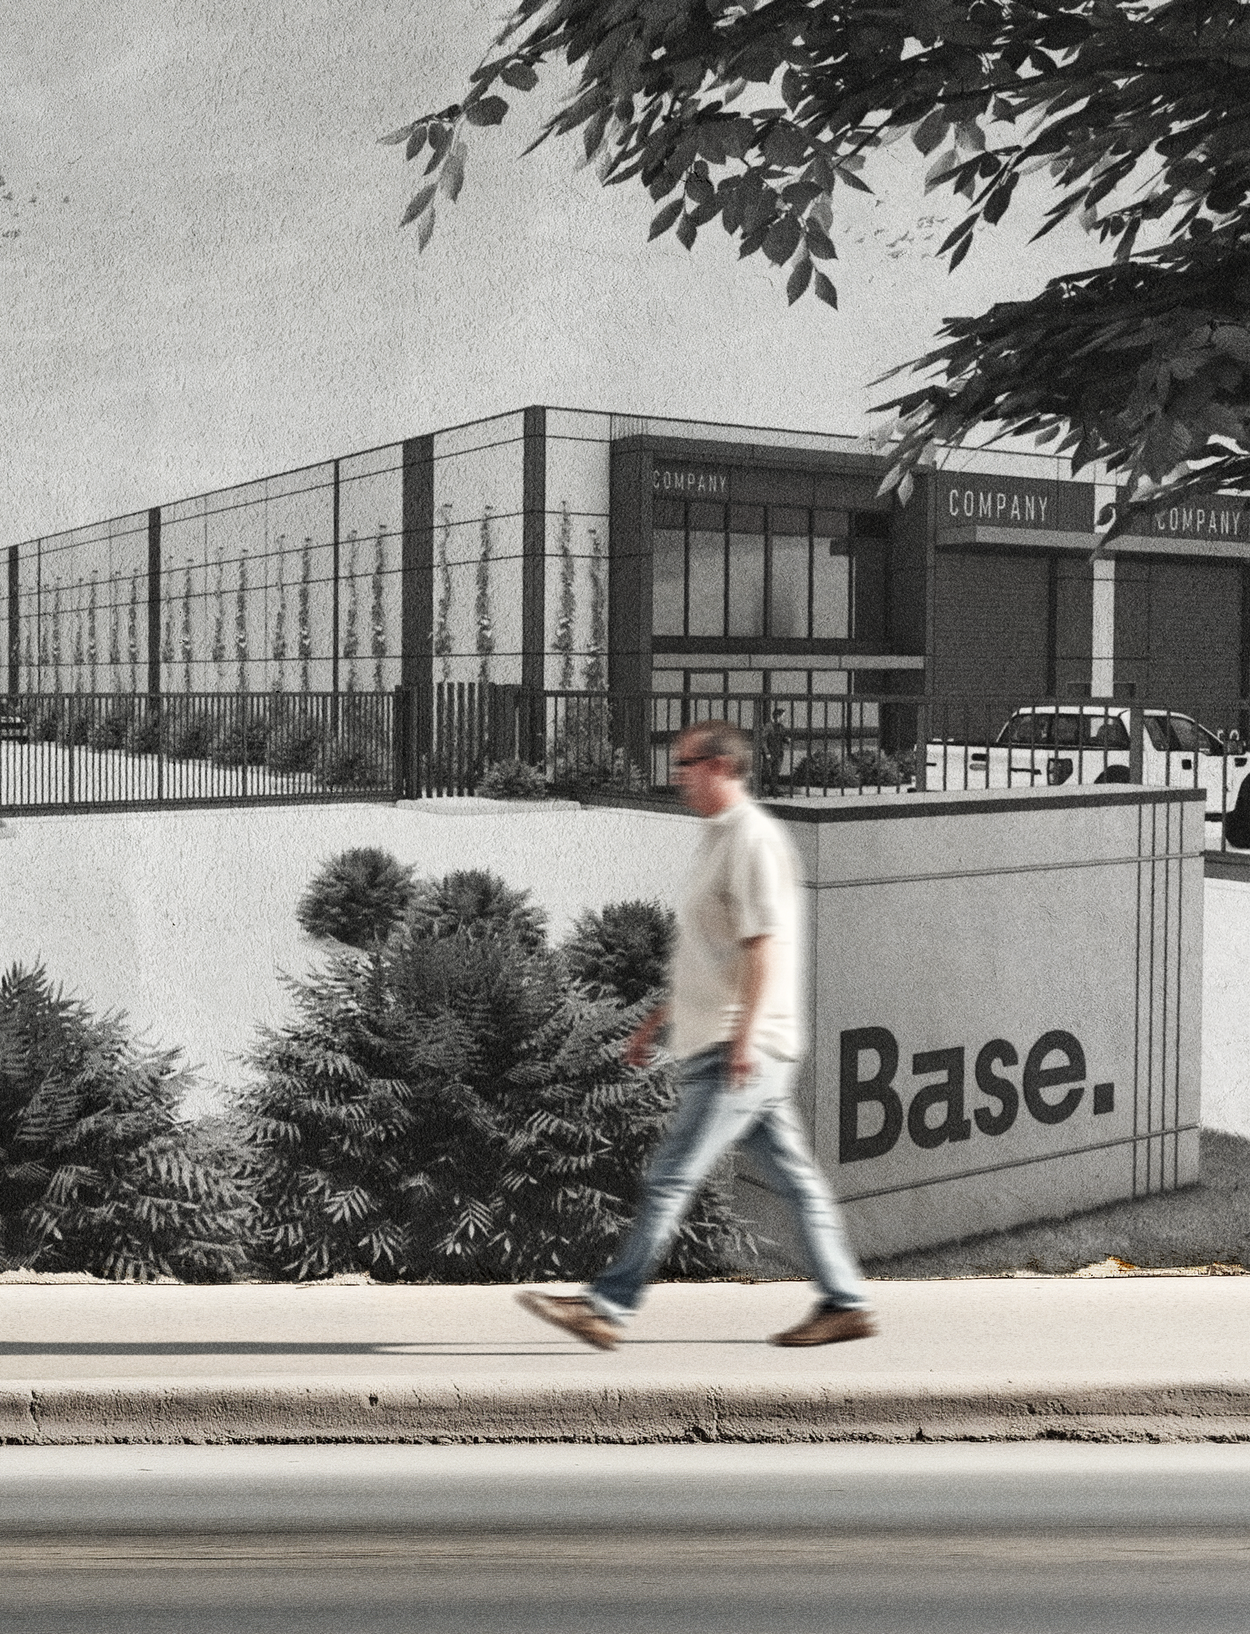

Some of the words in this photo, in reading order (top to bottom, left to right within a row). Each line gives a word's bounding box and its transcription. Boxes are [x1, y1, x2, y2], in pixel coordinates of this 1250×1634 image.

[653, 469, 727, 493] COMPANY
[949, 488, 1048, 522] COMPANY
[839, 1026, 1115, 1165] Base.
